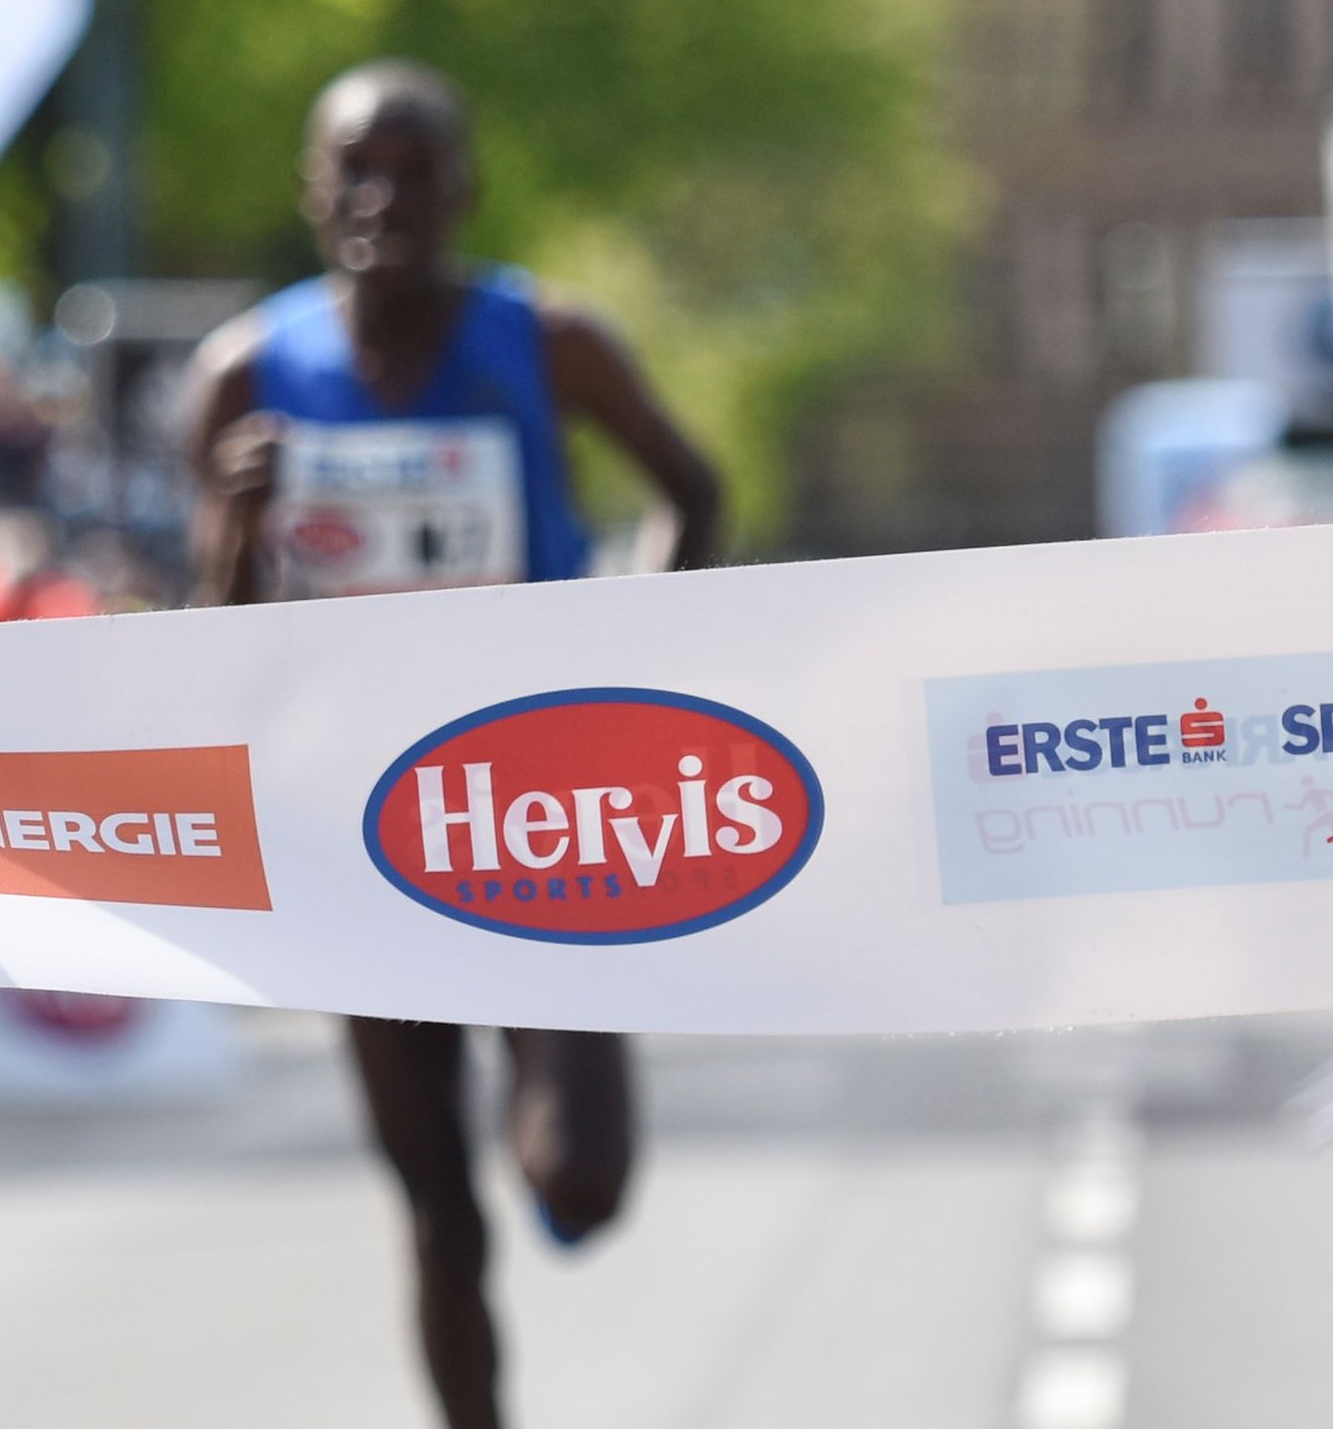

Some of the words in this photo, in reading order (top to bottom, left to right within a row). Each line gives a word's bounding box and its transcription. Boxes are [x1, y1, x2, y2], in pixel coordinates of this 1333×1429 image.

[986, 714, 1171, 776] ERSTE
[1182, 749, 1227, 765] BANK
[413, 754, 783, 888] Hervis
[456, 875, 624, 905] SPORTS
